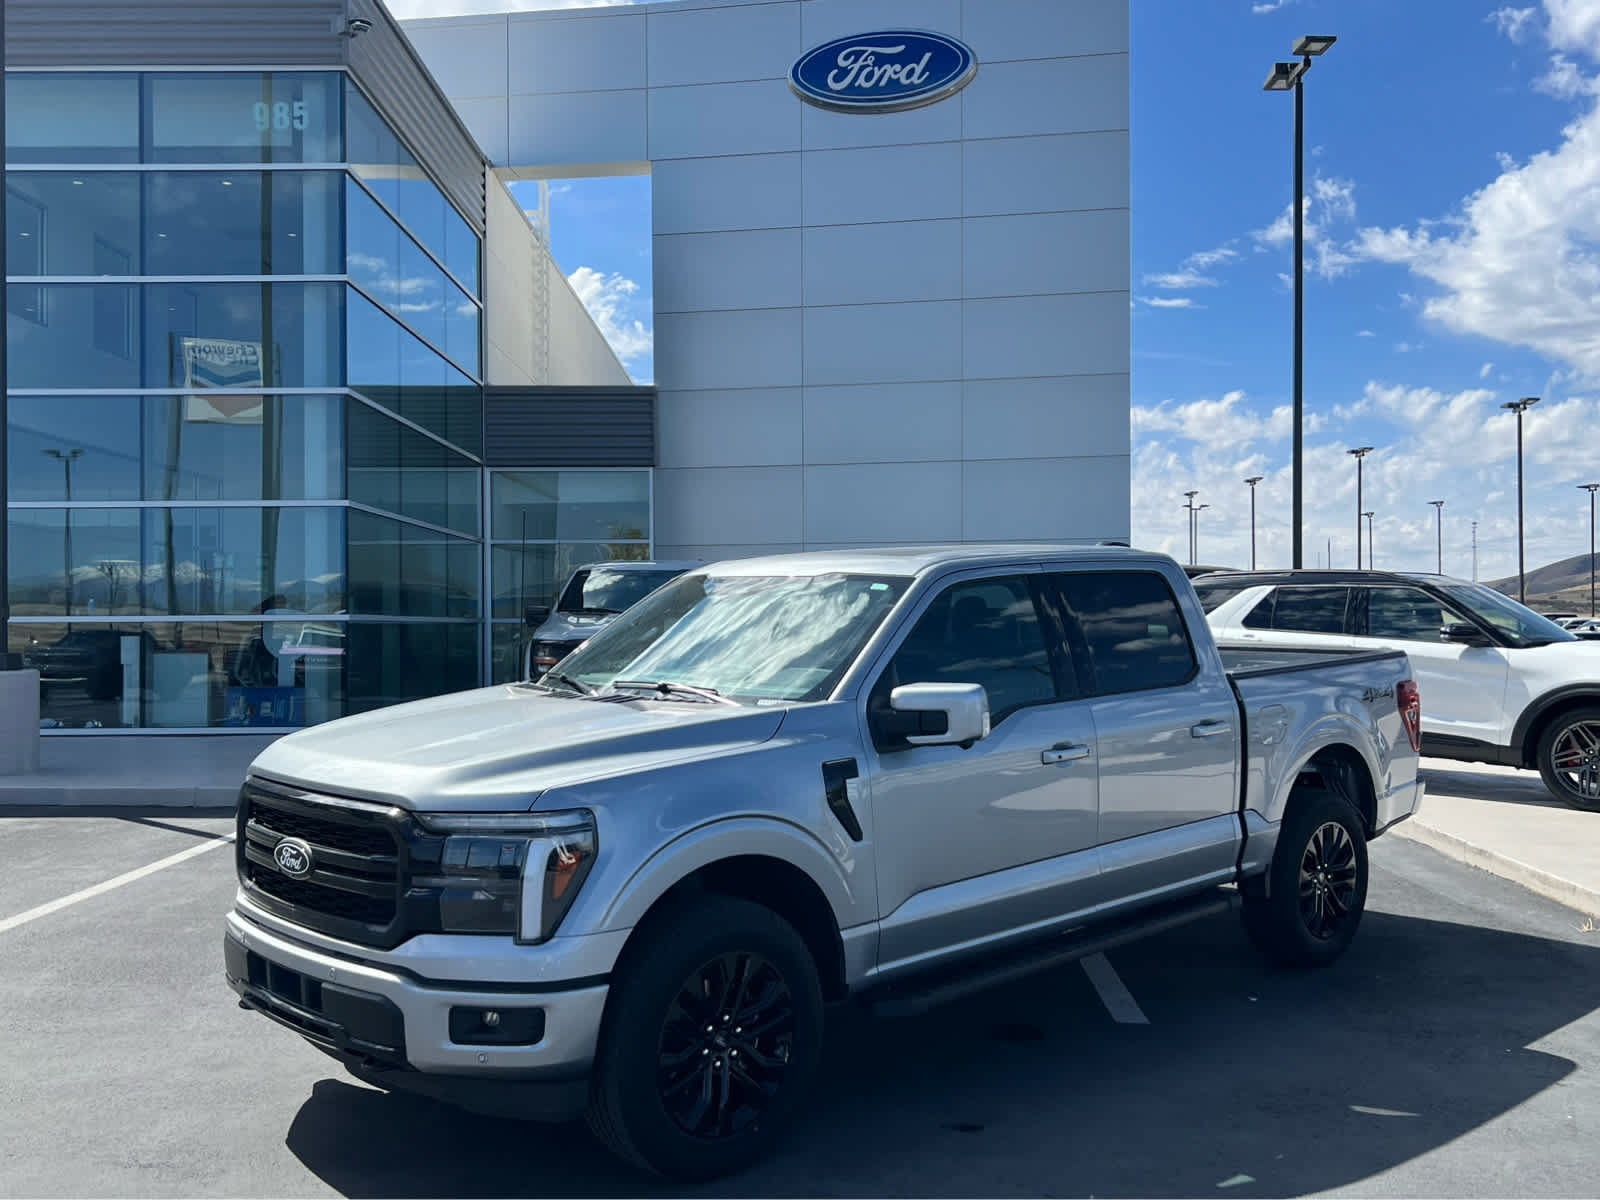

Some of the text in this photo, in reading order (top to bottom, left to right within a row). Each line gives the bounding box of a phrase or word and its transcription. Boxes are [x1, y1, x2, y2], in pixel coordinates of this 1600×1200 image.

[827, 45, 933, 91] Ford
[253, 101, 309, 131] 985
[280, 846, 302, 870] Ford
